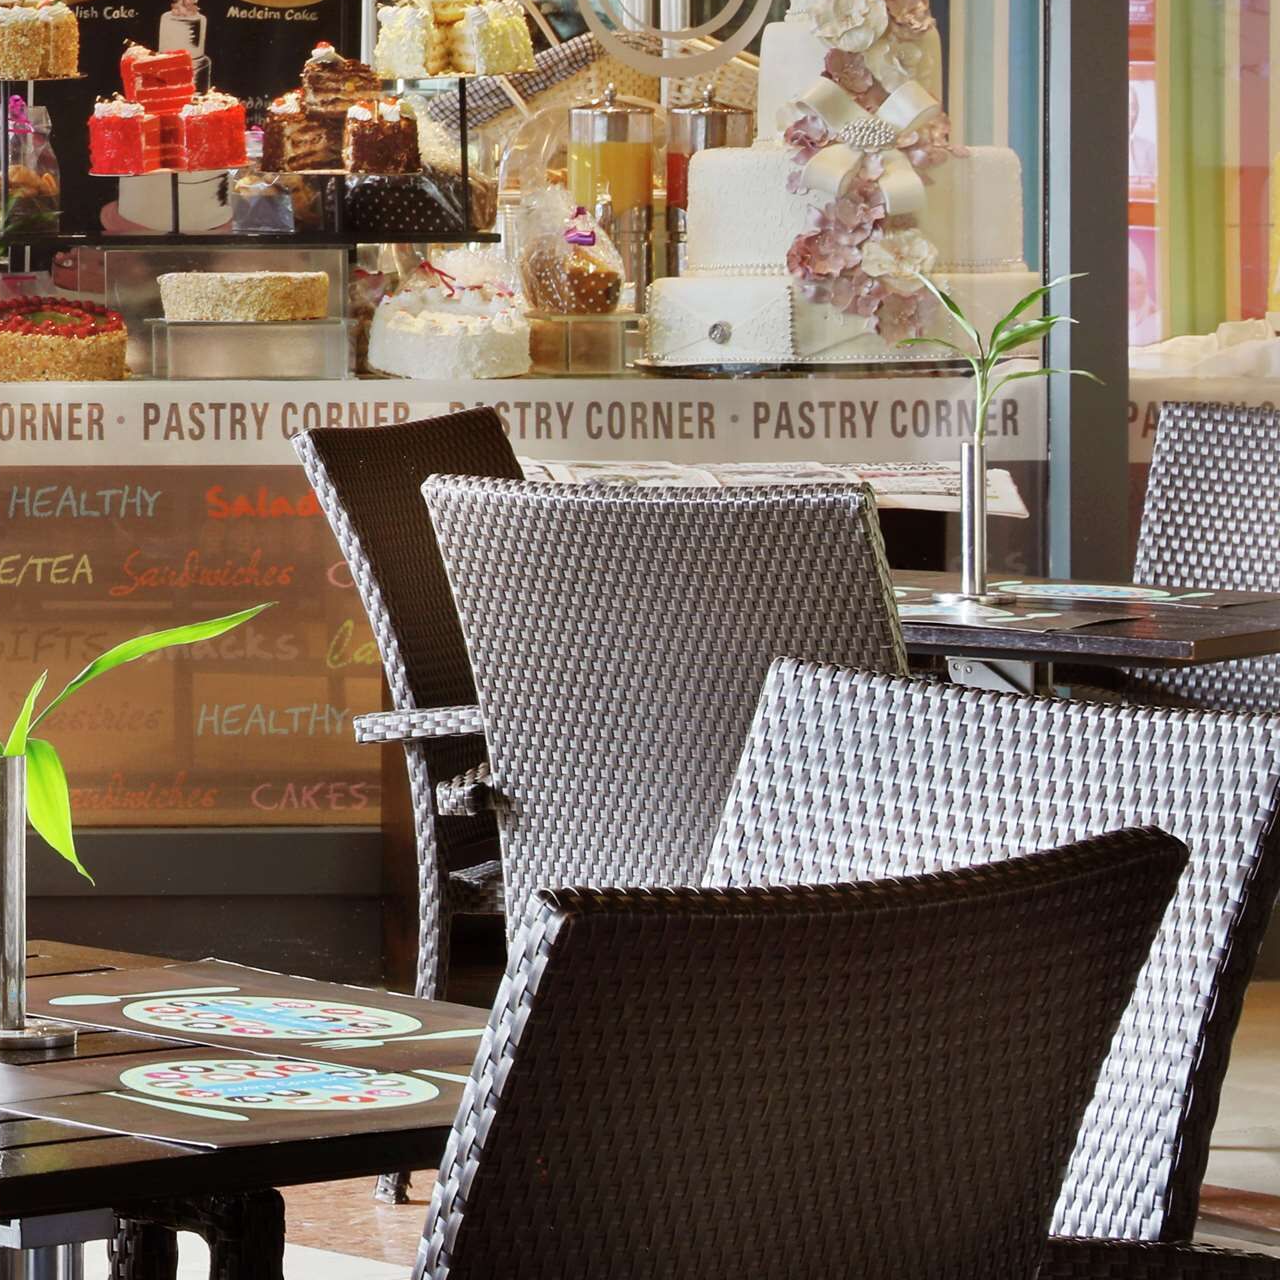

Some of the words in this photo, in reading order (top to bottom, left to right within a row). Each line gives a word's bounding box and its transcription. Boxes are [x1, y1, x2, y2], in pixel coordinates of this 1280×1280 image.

[285, 8, 319, 21] Cake
[143, 401, 269, 441] PASTRY
[586, 400, 716, 440] CORNER
[753, 399, 879, 440] PASTRY
[892, 398, 1021, 439] CORNER
[7, 484, 162, 520] HEALTHY
[109, 550, 297, 597] Sandwiches
[195, 702, 351, 737] HEALTHY
[72, 770, 220, 813] andwiches
[250, 782, 371, 813] CAKES
